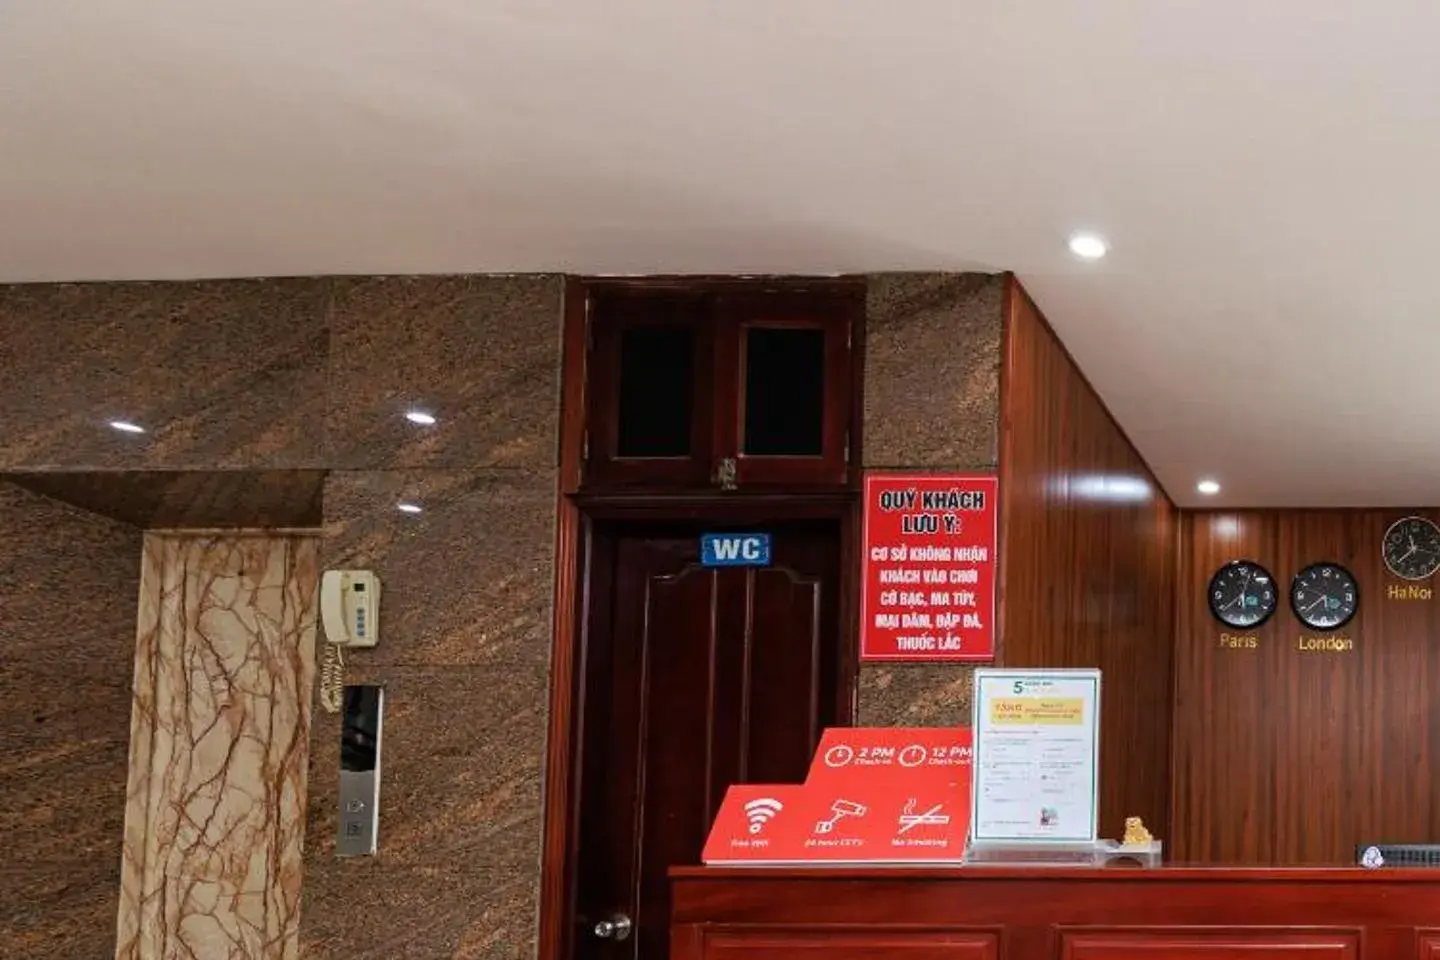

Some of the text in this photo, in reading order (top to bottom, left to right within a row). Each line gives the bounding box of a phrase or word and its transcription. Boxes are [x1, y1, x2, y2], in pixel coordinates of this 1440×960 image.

[922, 487, 985, 511] KHÁCH
[903, 514, 938, 534] LƯU
[712, 538, 760, 560] WC
[930, 592, 950, 606] MA
[1220, 633, 1257, 649] Paris
[1299, 635, 1353, 650] London
[858, 746, 895, 758] 2 PM
[932, 746, 973, 758] 12 PM
